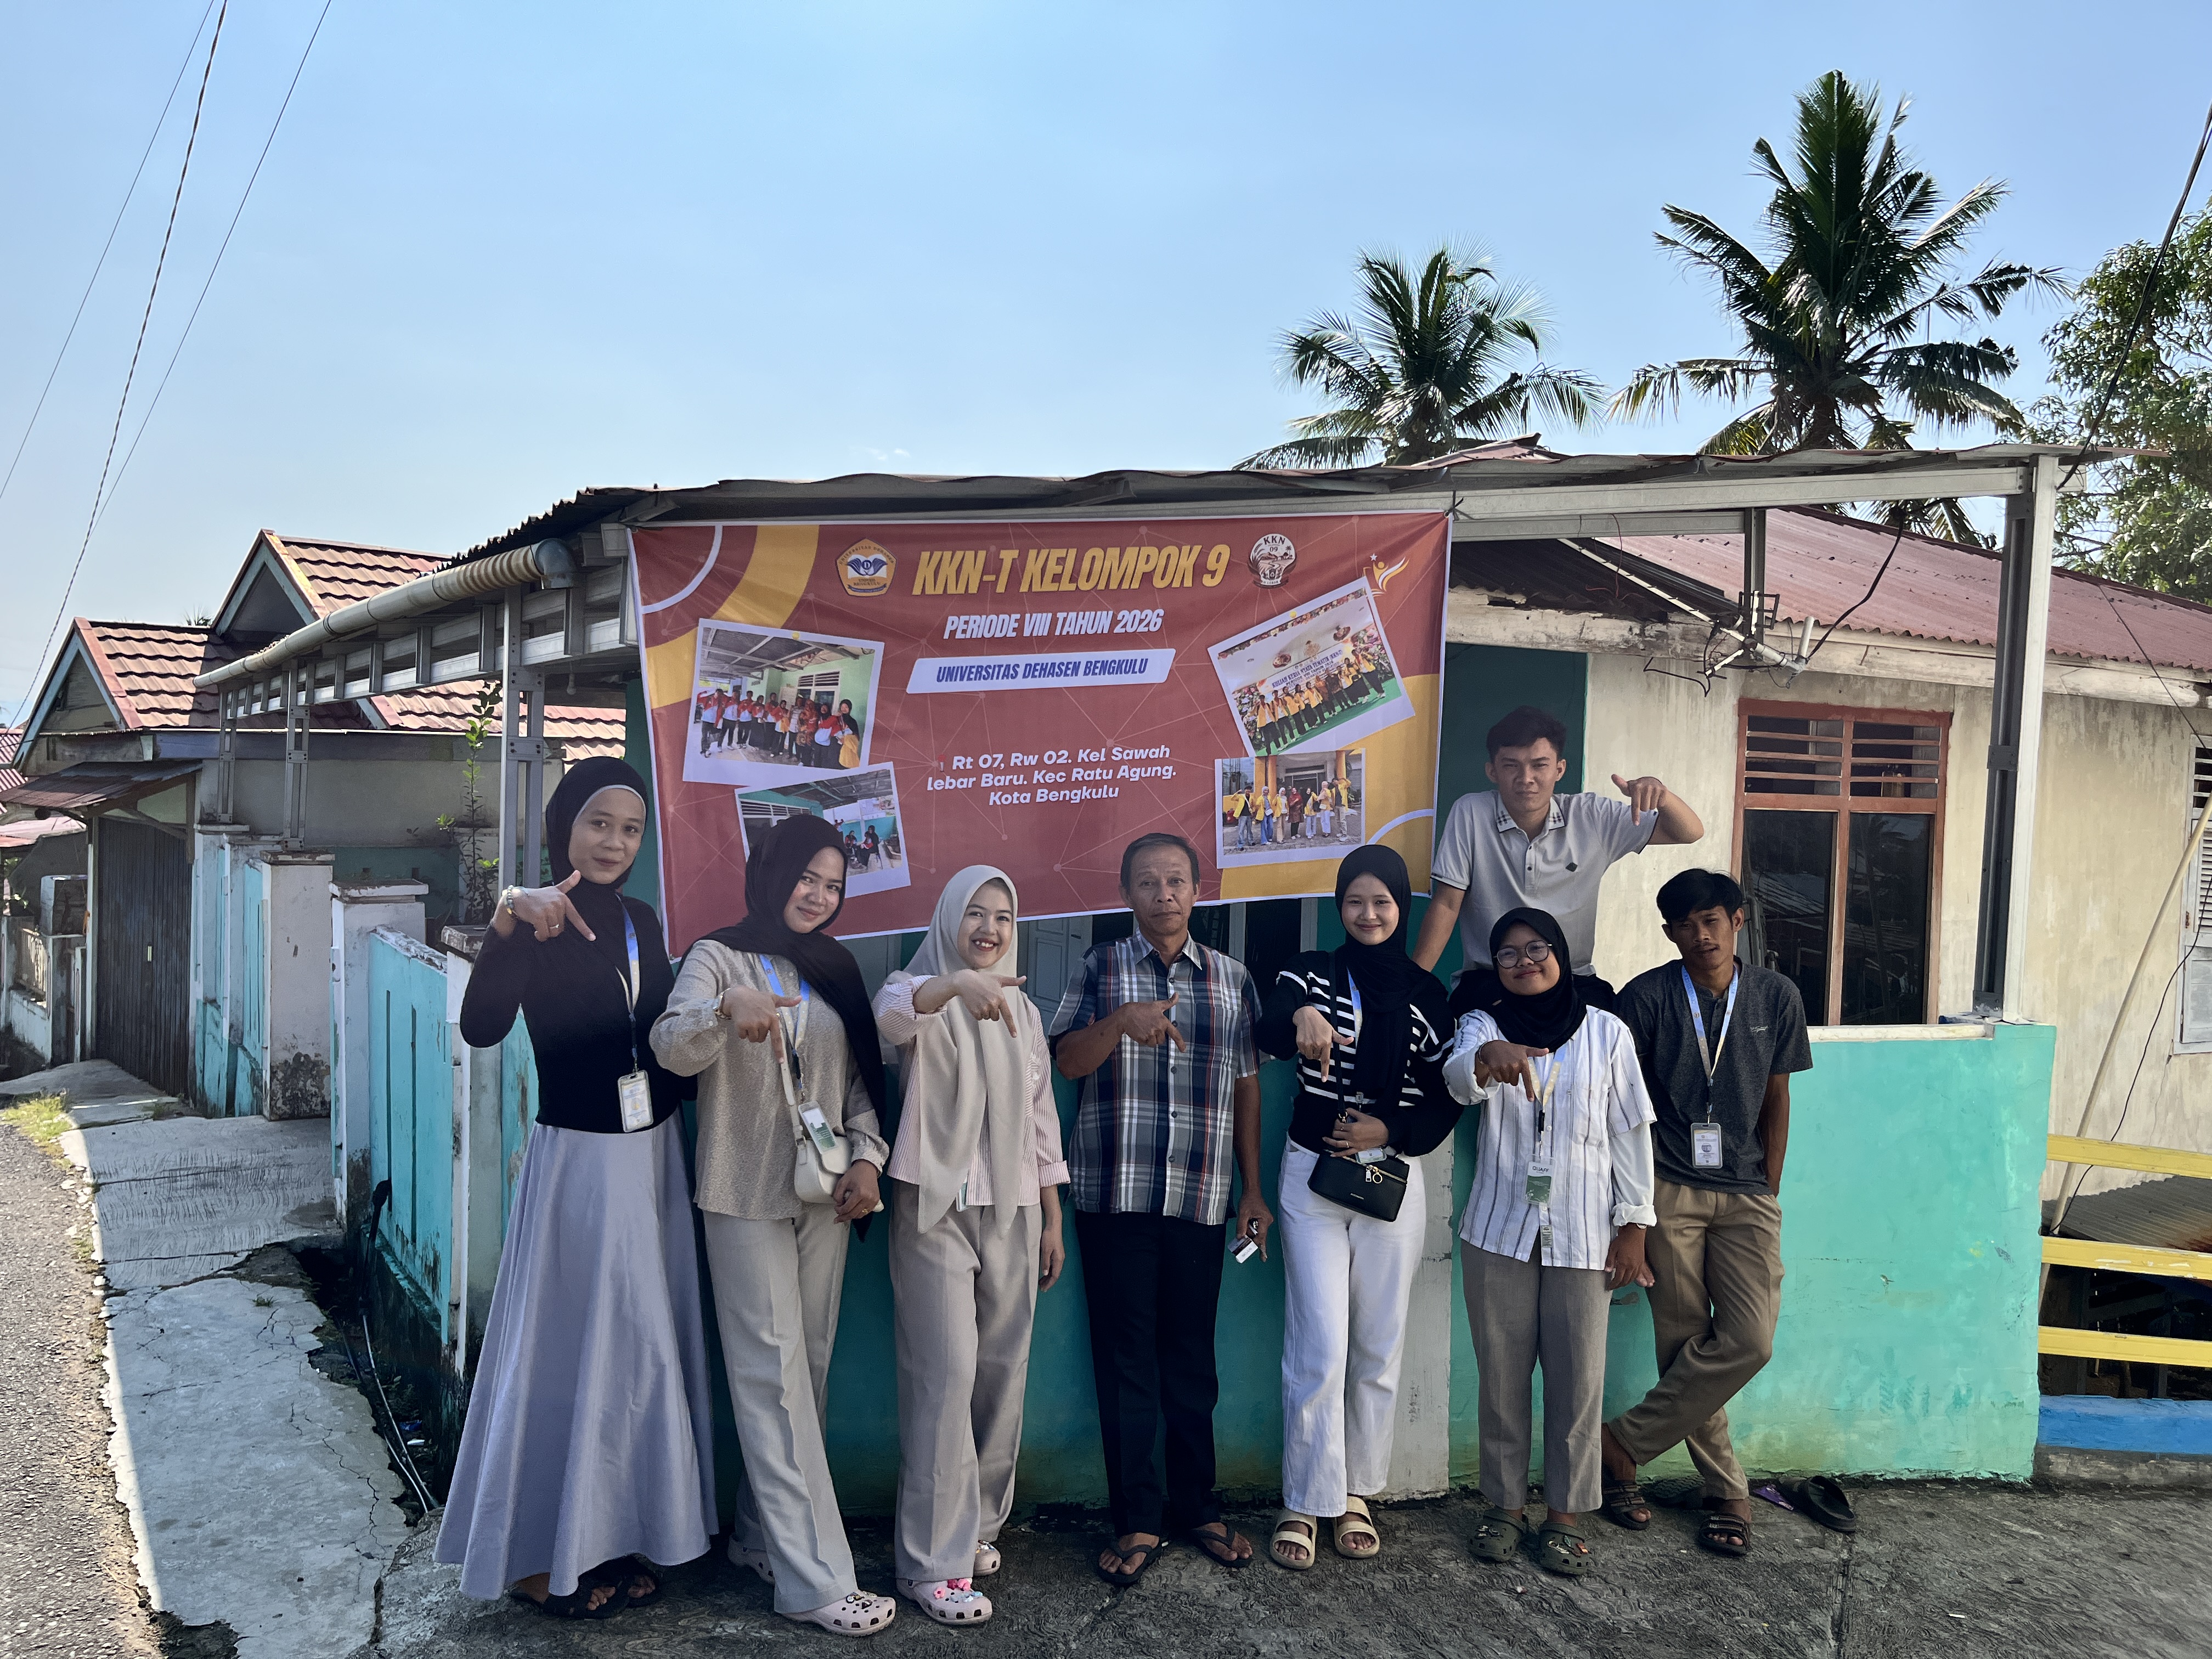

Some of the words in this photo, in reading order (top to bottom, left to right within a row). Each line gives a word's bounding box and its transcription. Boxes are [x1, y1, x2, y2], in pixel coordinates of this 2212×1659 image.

[1263, 535, 1285, 545] KKN
[912, 549, 1019, 595] KKN-T
[1019, 545, 1203, 592] KELOMPOK
[1202, 544, 1231, 587] 9
[943, 613, 1020, 640] PERIODE
[1023, 612, 1053, 637] VIII
[1054, 610, 1114, 636] TAHUN
[1113, 608, 1165, 634] 2026
[936, 663, 1019, 682] UNIVERSITAS
[1022, 661, 1080, 679] DEHASEN
[1083, 658, 1149, 676] BENGKULU
[952, 755, 974, 770] Rt
[978, 753, 1004, 770] 07,
[1010, 753, 1039, 766] Rw
[1043, 749, 1072, 765] 02.
[1077, 748, 1106, 763] Kel
[1111, 744, 1170, 761] Sawah
[980, 772, 1028, 787] Baru.
[1032, 770, 1066, 784] Kec
[1071, 768, 1113, 782] Ratu
[1116, 764, 1176, 782] Agung.
[989, 791, 1031, 806] Kota
[1036, 785, 1119, 804] Bengkulu
